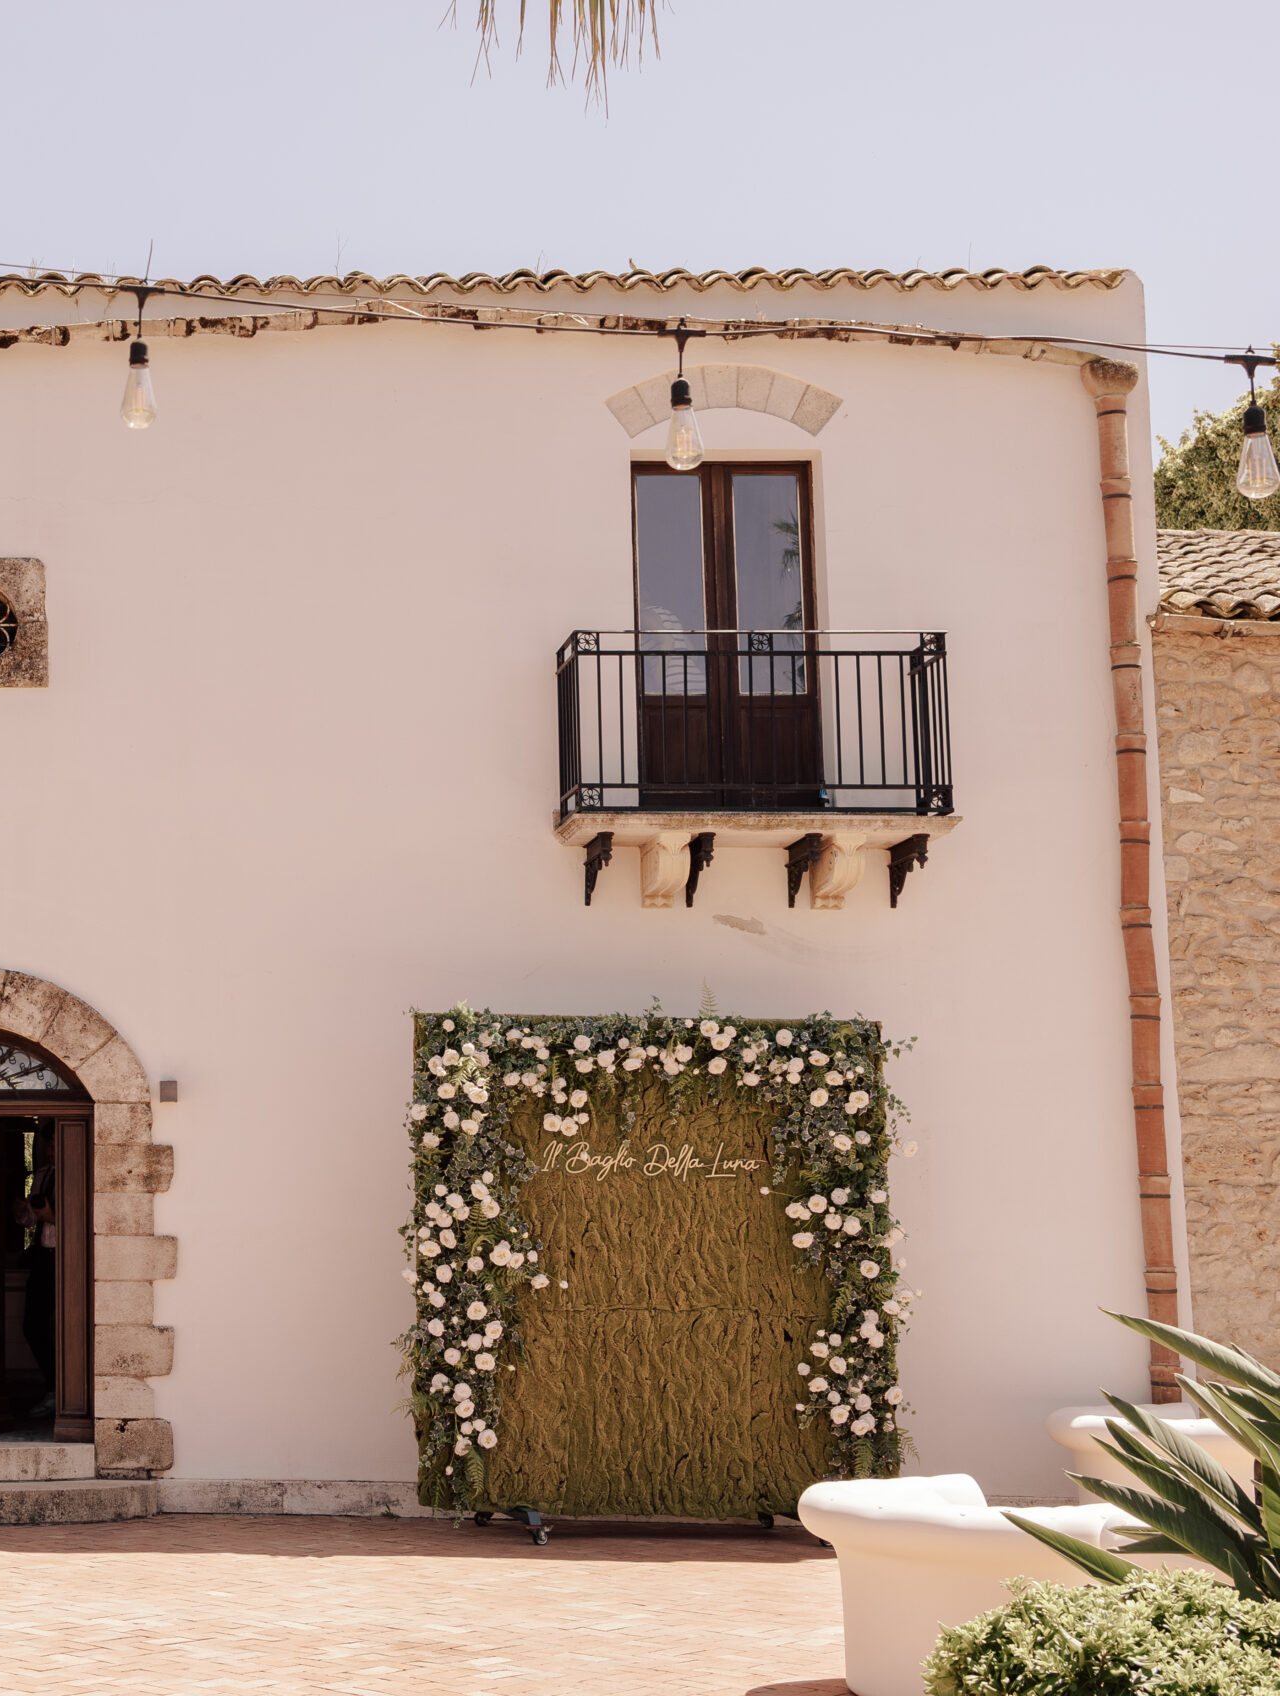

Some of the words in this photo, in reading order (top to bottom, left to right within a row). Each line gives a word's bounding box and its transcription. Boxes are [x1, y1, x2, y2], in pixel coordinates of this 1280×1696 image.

[541, 1139, 561, 1172] Il
[565, 1140, 636, 1182] Baglio
[643, 1142, 704, 1182] Della
[705, 1141, 760, 1178] Luna
